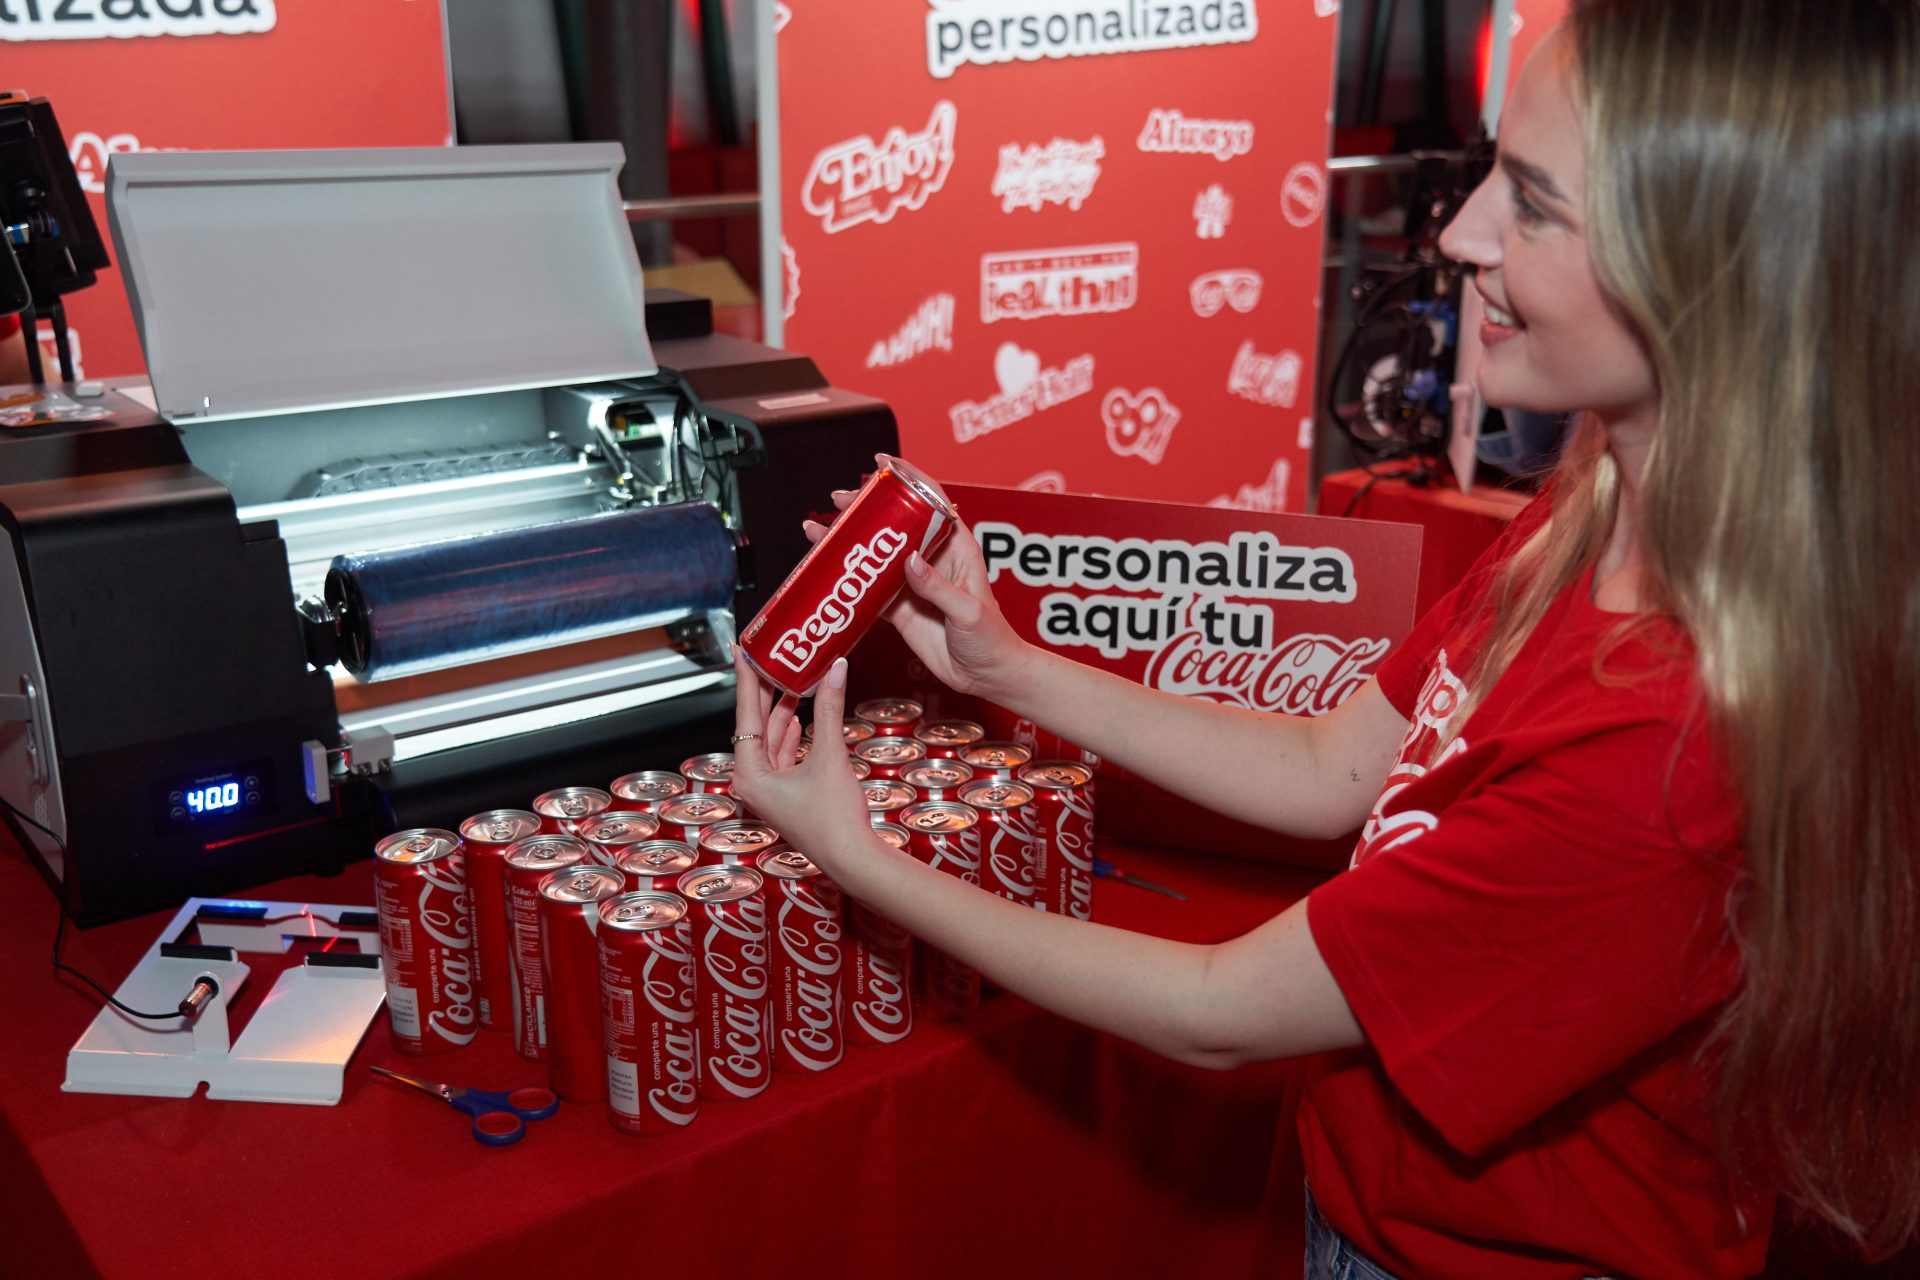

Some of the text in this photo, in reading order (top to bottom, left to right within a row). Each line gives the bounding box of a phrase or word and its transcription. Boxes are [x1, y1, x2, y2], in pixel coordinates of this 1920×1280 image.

[938, 0, 1248, 65] personalizada
[982, 532, 1347, 593] Personaliza
[772, 529, 905, 671] Begoña
[1046, 597, 1264, 649] aquí tu
[1150, 631, 1386, 717] Coca-Cola
[187, 782, 239, 813] 40.0
[1056, 783, 1095, 920] ca-Cola
[1058, 888, 1067, 916] omparte
[416, 850, 478, 1045] Coca-Cola
[428, 947, 440, 1003] comparte una
[778, 878, 844, 1071] Coca-Cola
[856, 956, 864, 995] comparte
[642, 921, 699, 1126] Coca-Cola
[704, 893, 769, 1098] Coca-Cola
[785, 984, 793, 1022] comparte
[651, 1021, 662, 1080] comparte una
[713, 1011, 721, 1049] comparte
